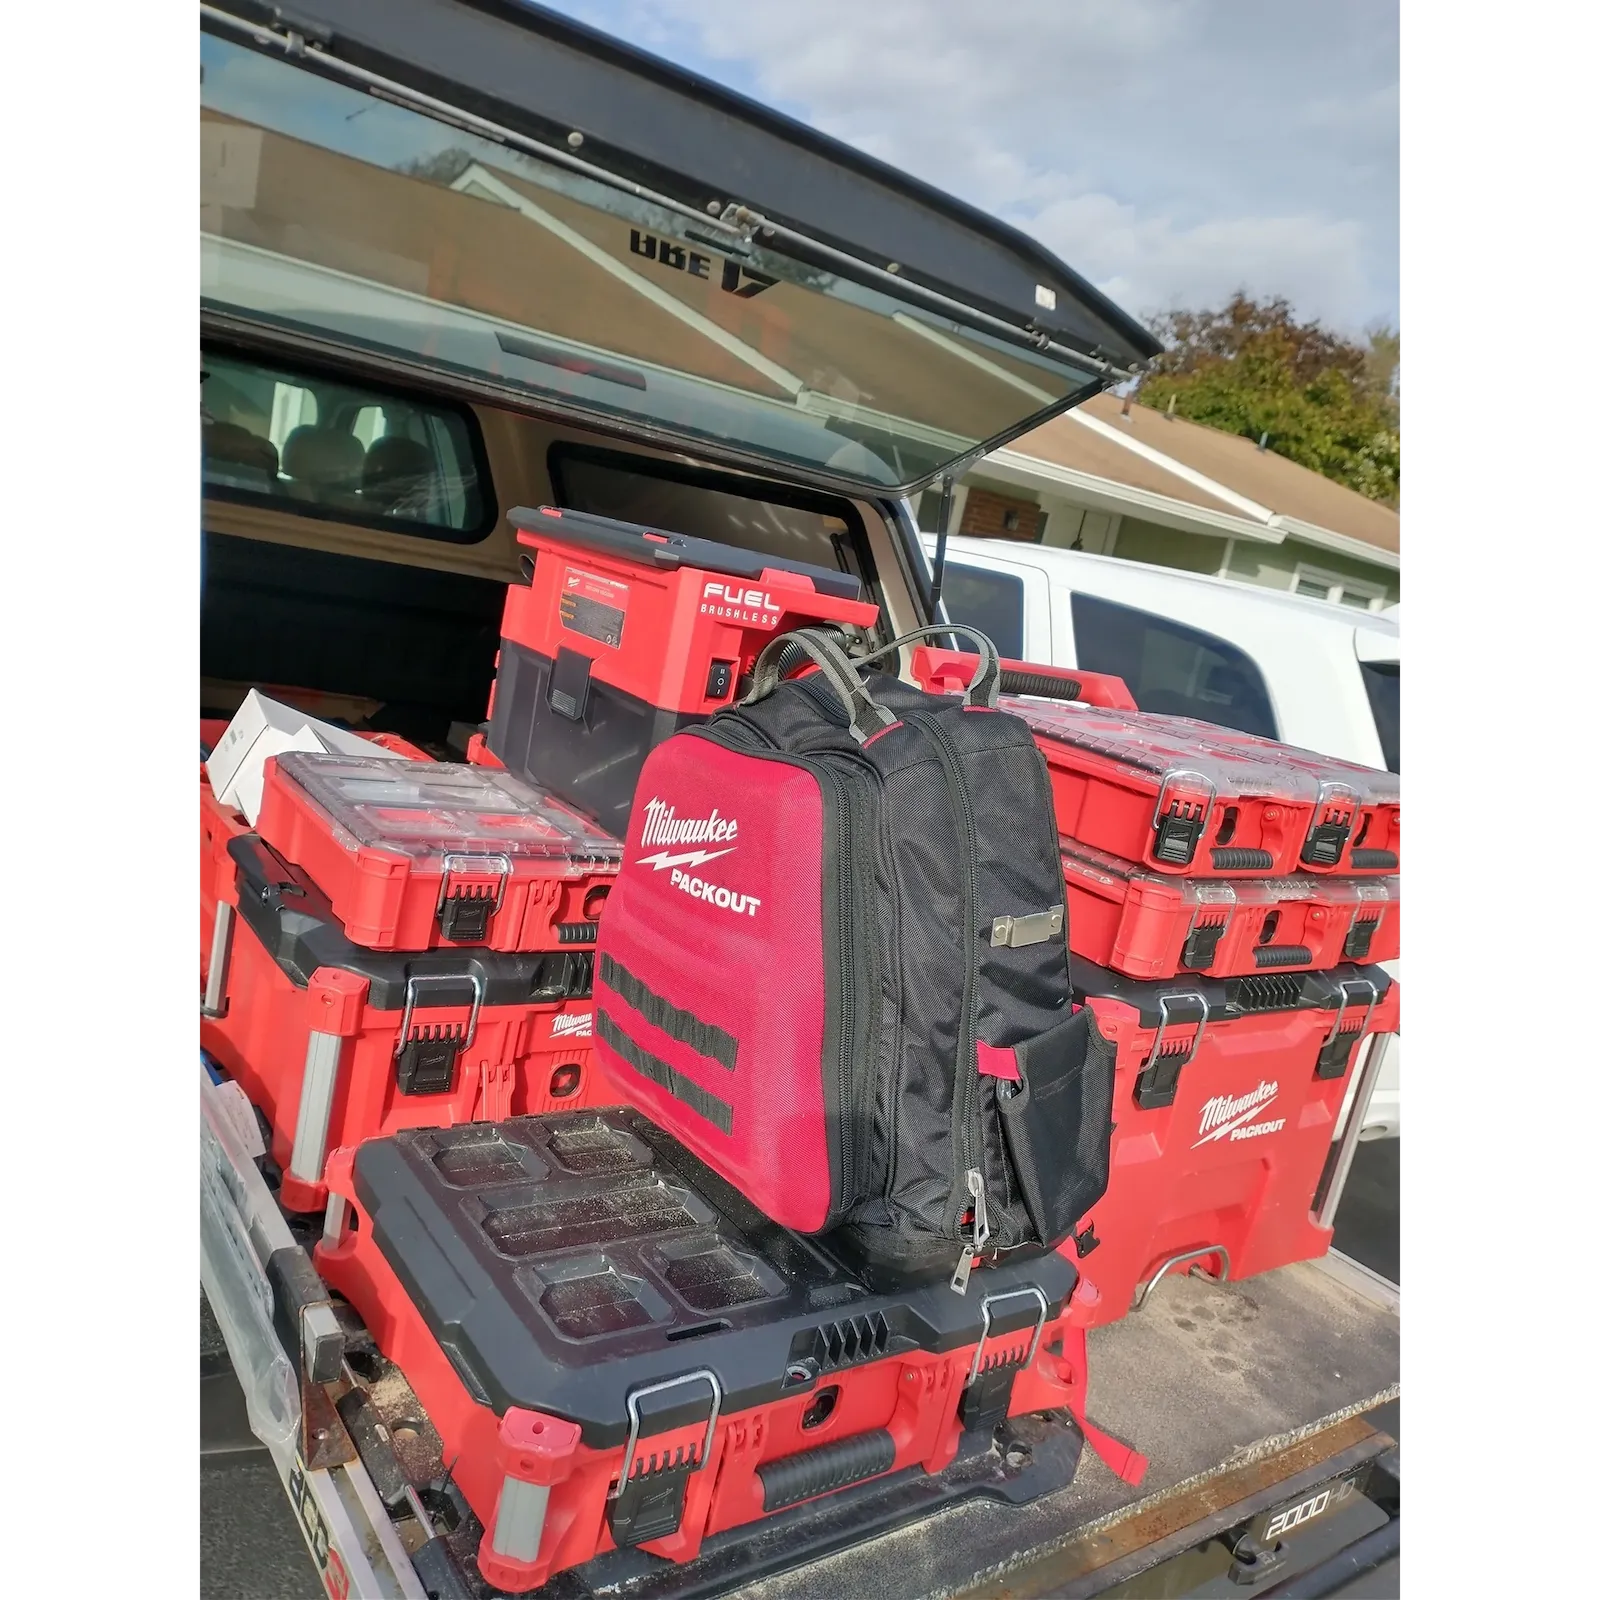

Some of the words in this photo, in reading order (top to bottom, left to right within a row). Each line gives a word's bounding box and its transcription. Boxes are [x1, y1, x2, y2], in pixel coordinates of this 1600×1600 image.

[700, 603, 778, 625] BRUSHLESS
[703, 582, 780, 611] FUEL
[641, 795, 738, 848] Milwaukee
[670, 868, 761, 916] PACKOUT
[1198, 1080, 1279, 1135] Milwaukee
[1229, 1118, 1287, 1141] PACKOUT
